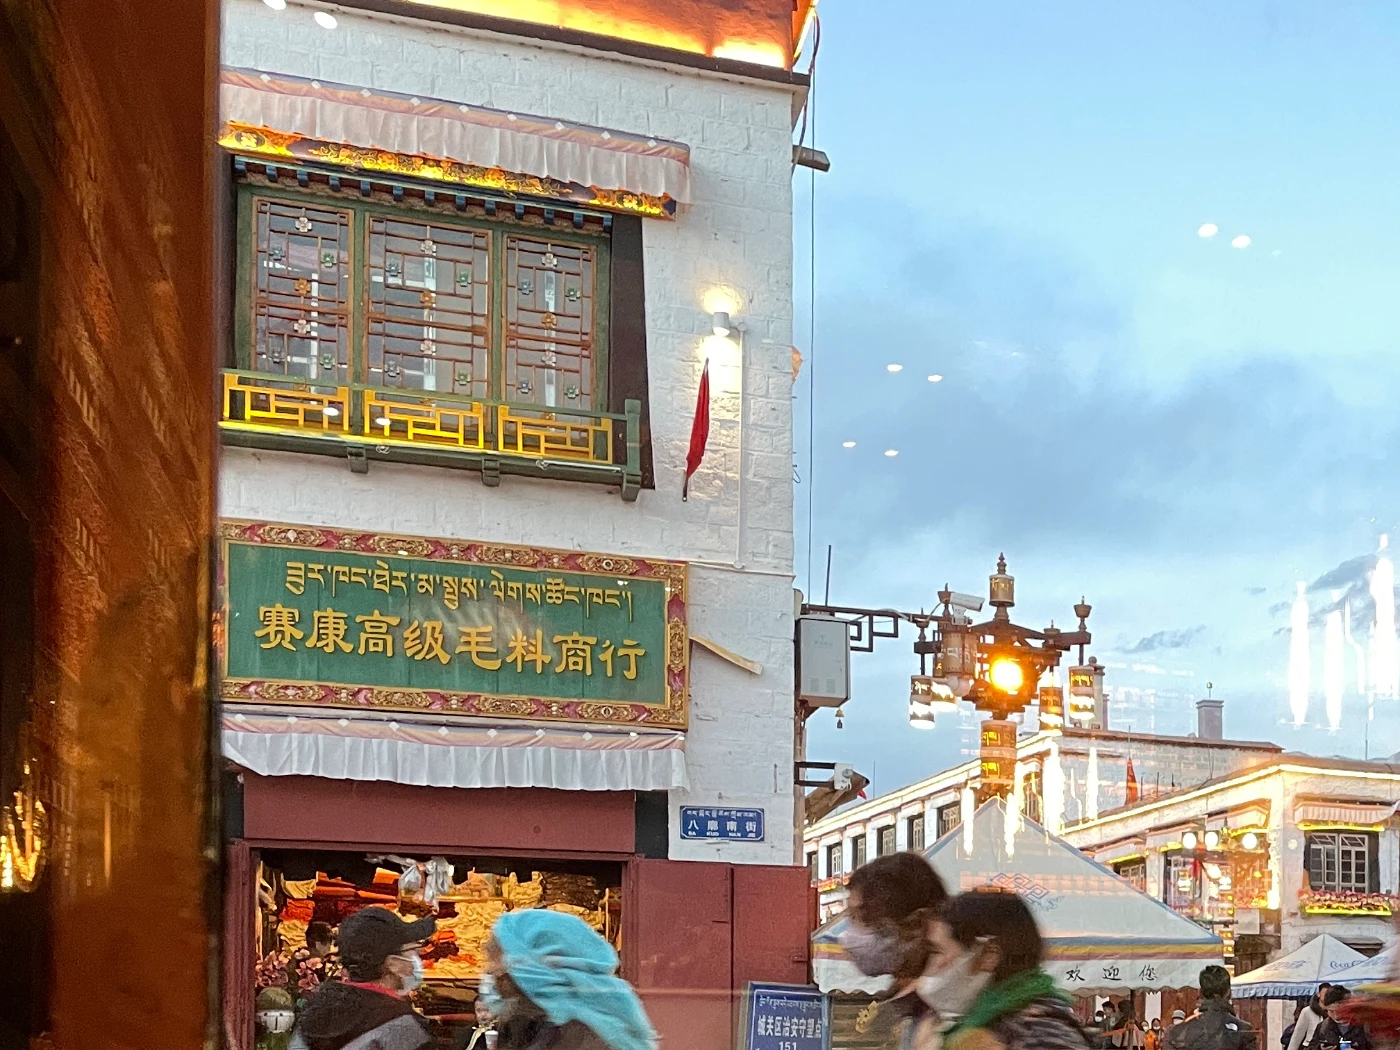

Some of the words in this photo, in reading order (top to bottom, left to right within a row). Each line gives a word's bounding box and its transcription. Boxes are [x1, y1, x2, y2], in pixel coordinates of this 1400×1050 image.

[254, 603, 646, 680] 赛康高级毛料商行
[687, 819, 757, 832] 八廓南街
[1066, 964, 1158, 982] 欢迎您
